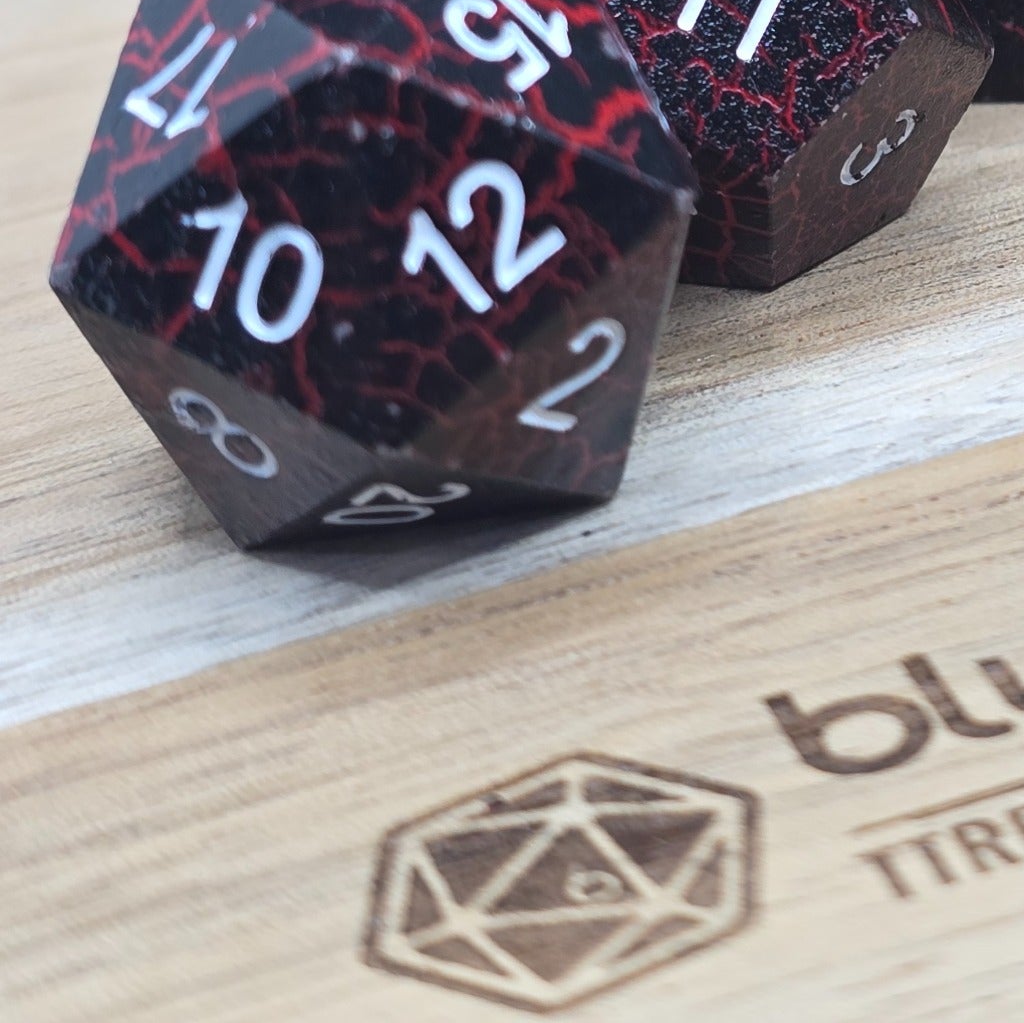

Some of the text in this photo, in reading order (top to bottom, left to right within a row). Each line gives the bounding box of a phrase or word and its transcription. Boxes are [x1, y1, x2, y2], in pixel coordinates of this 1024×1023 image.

[123, 23, 237, 139] 17
[840, 109, 918, 185] 3
[181, 192, 324, 345] 10
[403, 160, 568, 314] 12
[168, 388, 279, 478] 8
[517, 317, 626, 433] 2
[322, 482, 471, 524] 20
